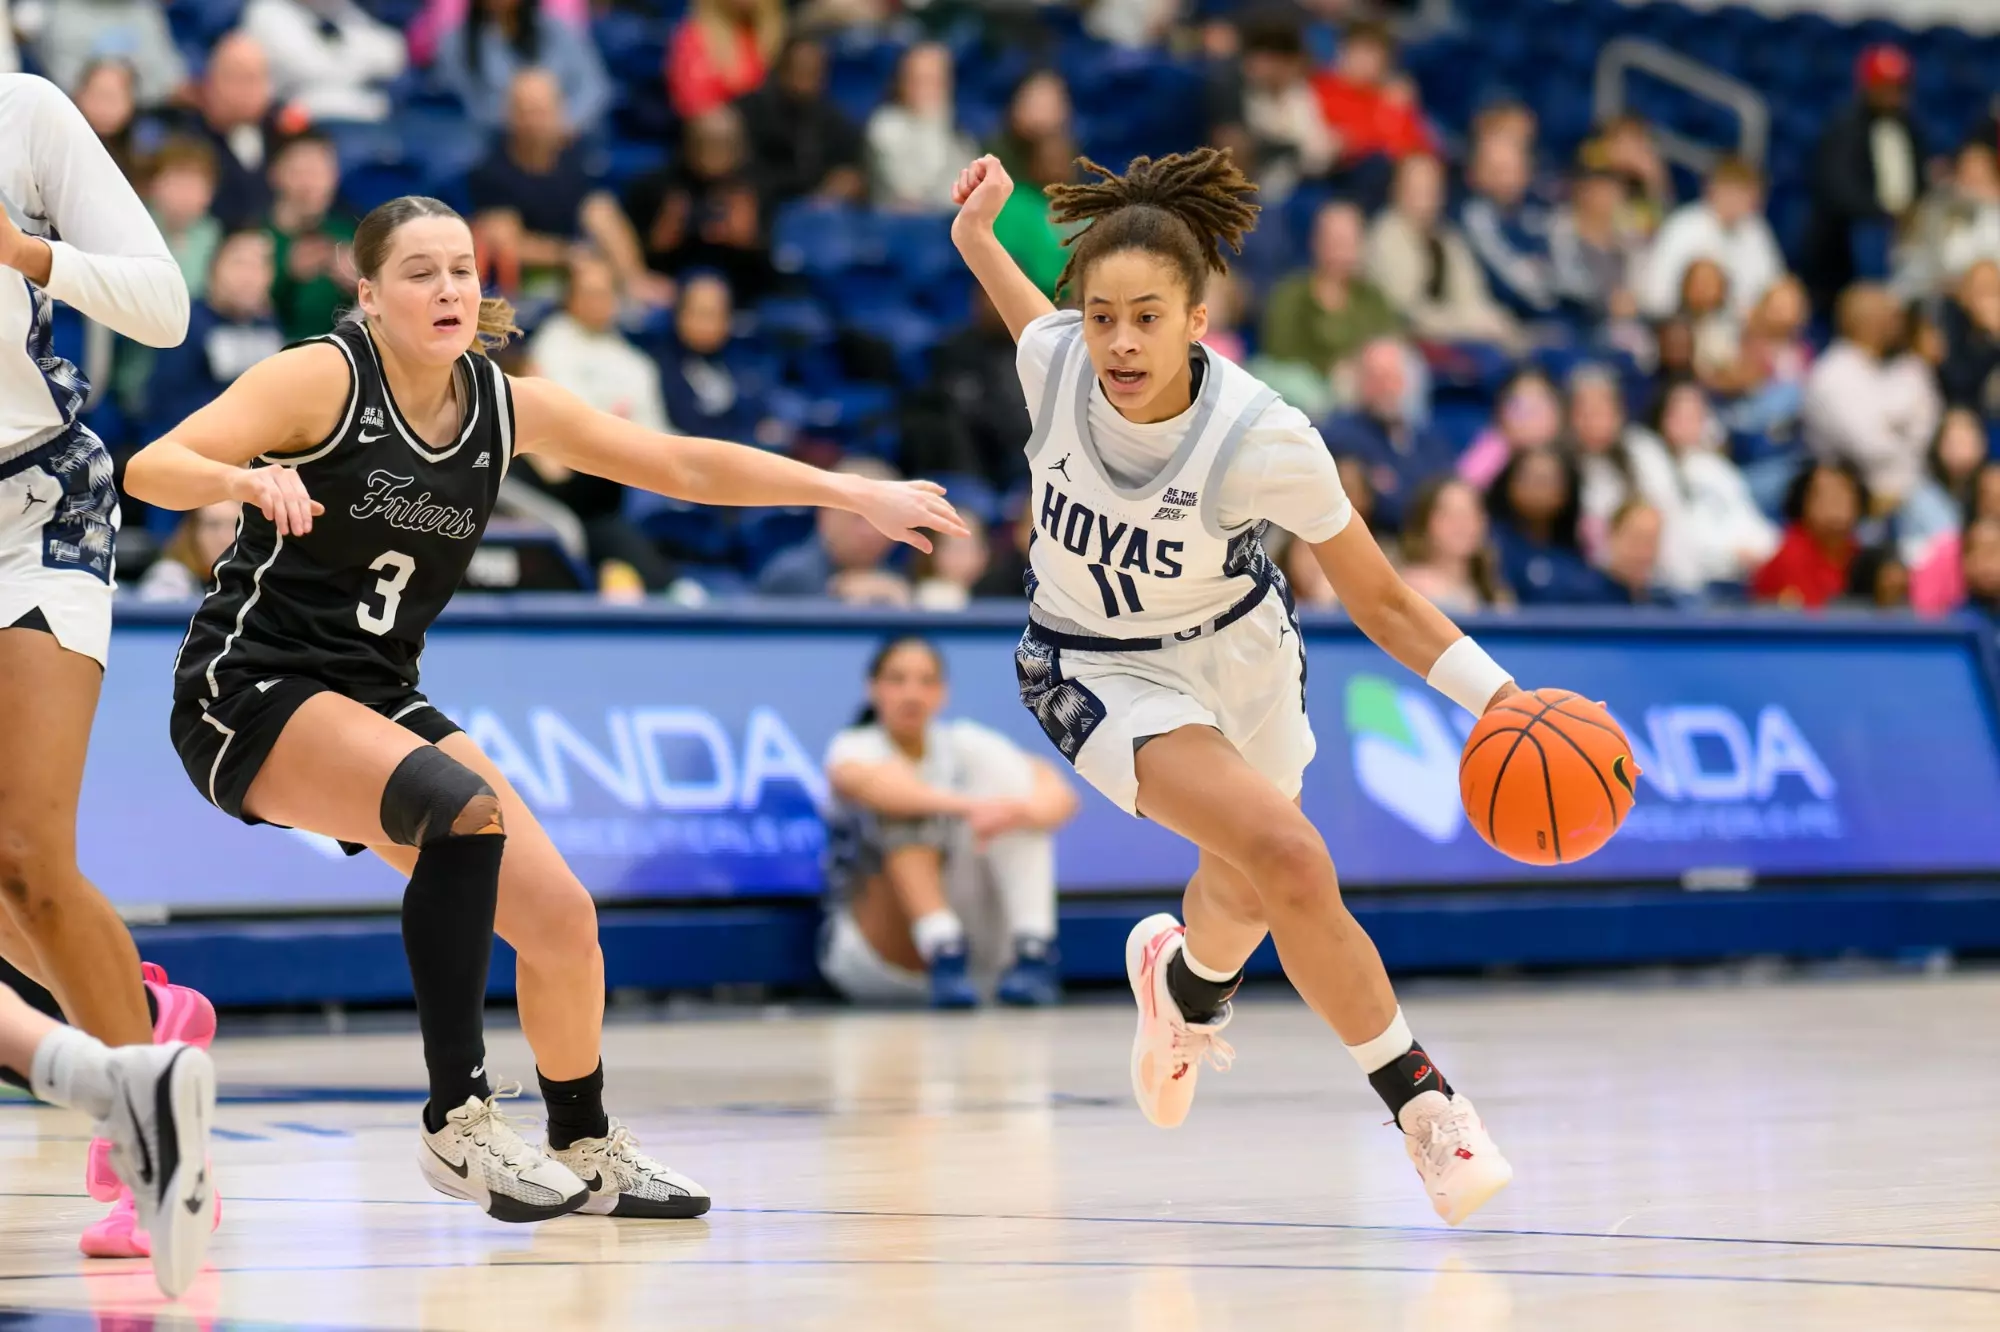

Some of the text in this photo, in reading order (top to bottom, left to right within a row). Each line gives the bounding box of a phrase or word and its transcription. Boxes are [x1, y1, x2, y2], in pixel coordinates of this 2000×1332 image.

[364, 407, 376, 416] BE
[350, 469, 475, 539] Friars
[1162, 494, 1198, 507] CHANGE
[1167, 487, 1198, 499] BE THE
[1152, 512, 1187, 521] EAST
[1158, 507, 1182, 515] BIG
[1041, 481, 1184, 579] HOYAS
[356, 550, 416, 636] 3
[1087, 564, 1145, 618] 11
[452, 704, 833, 813] ANDA
